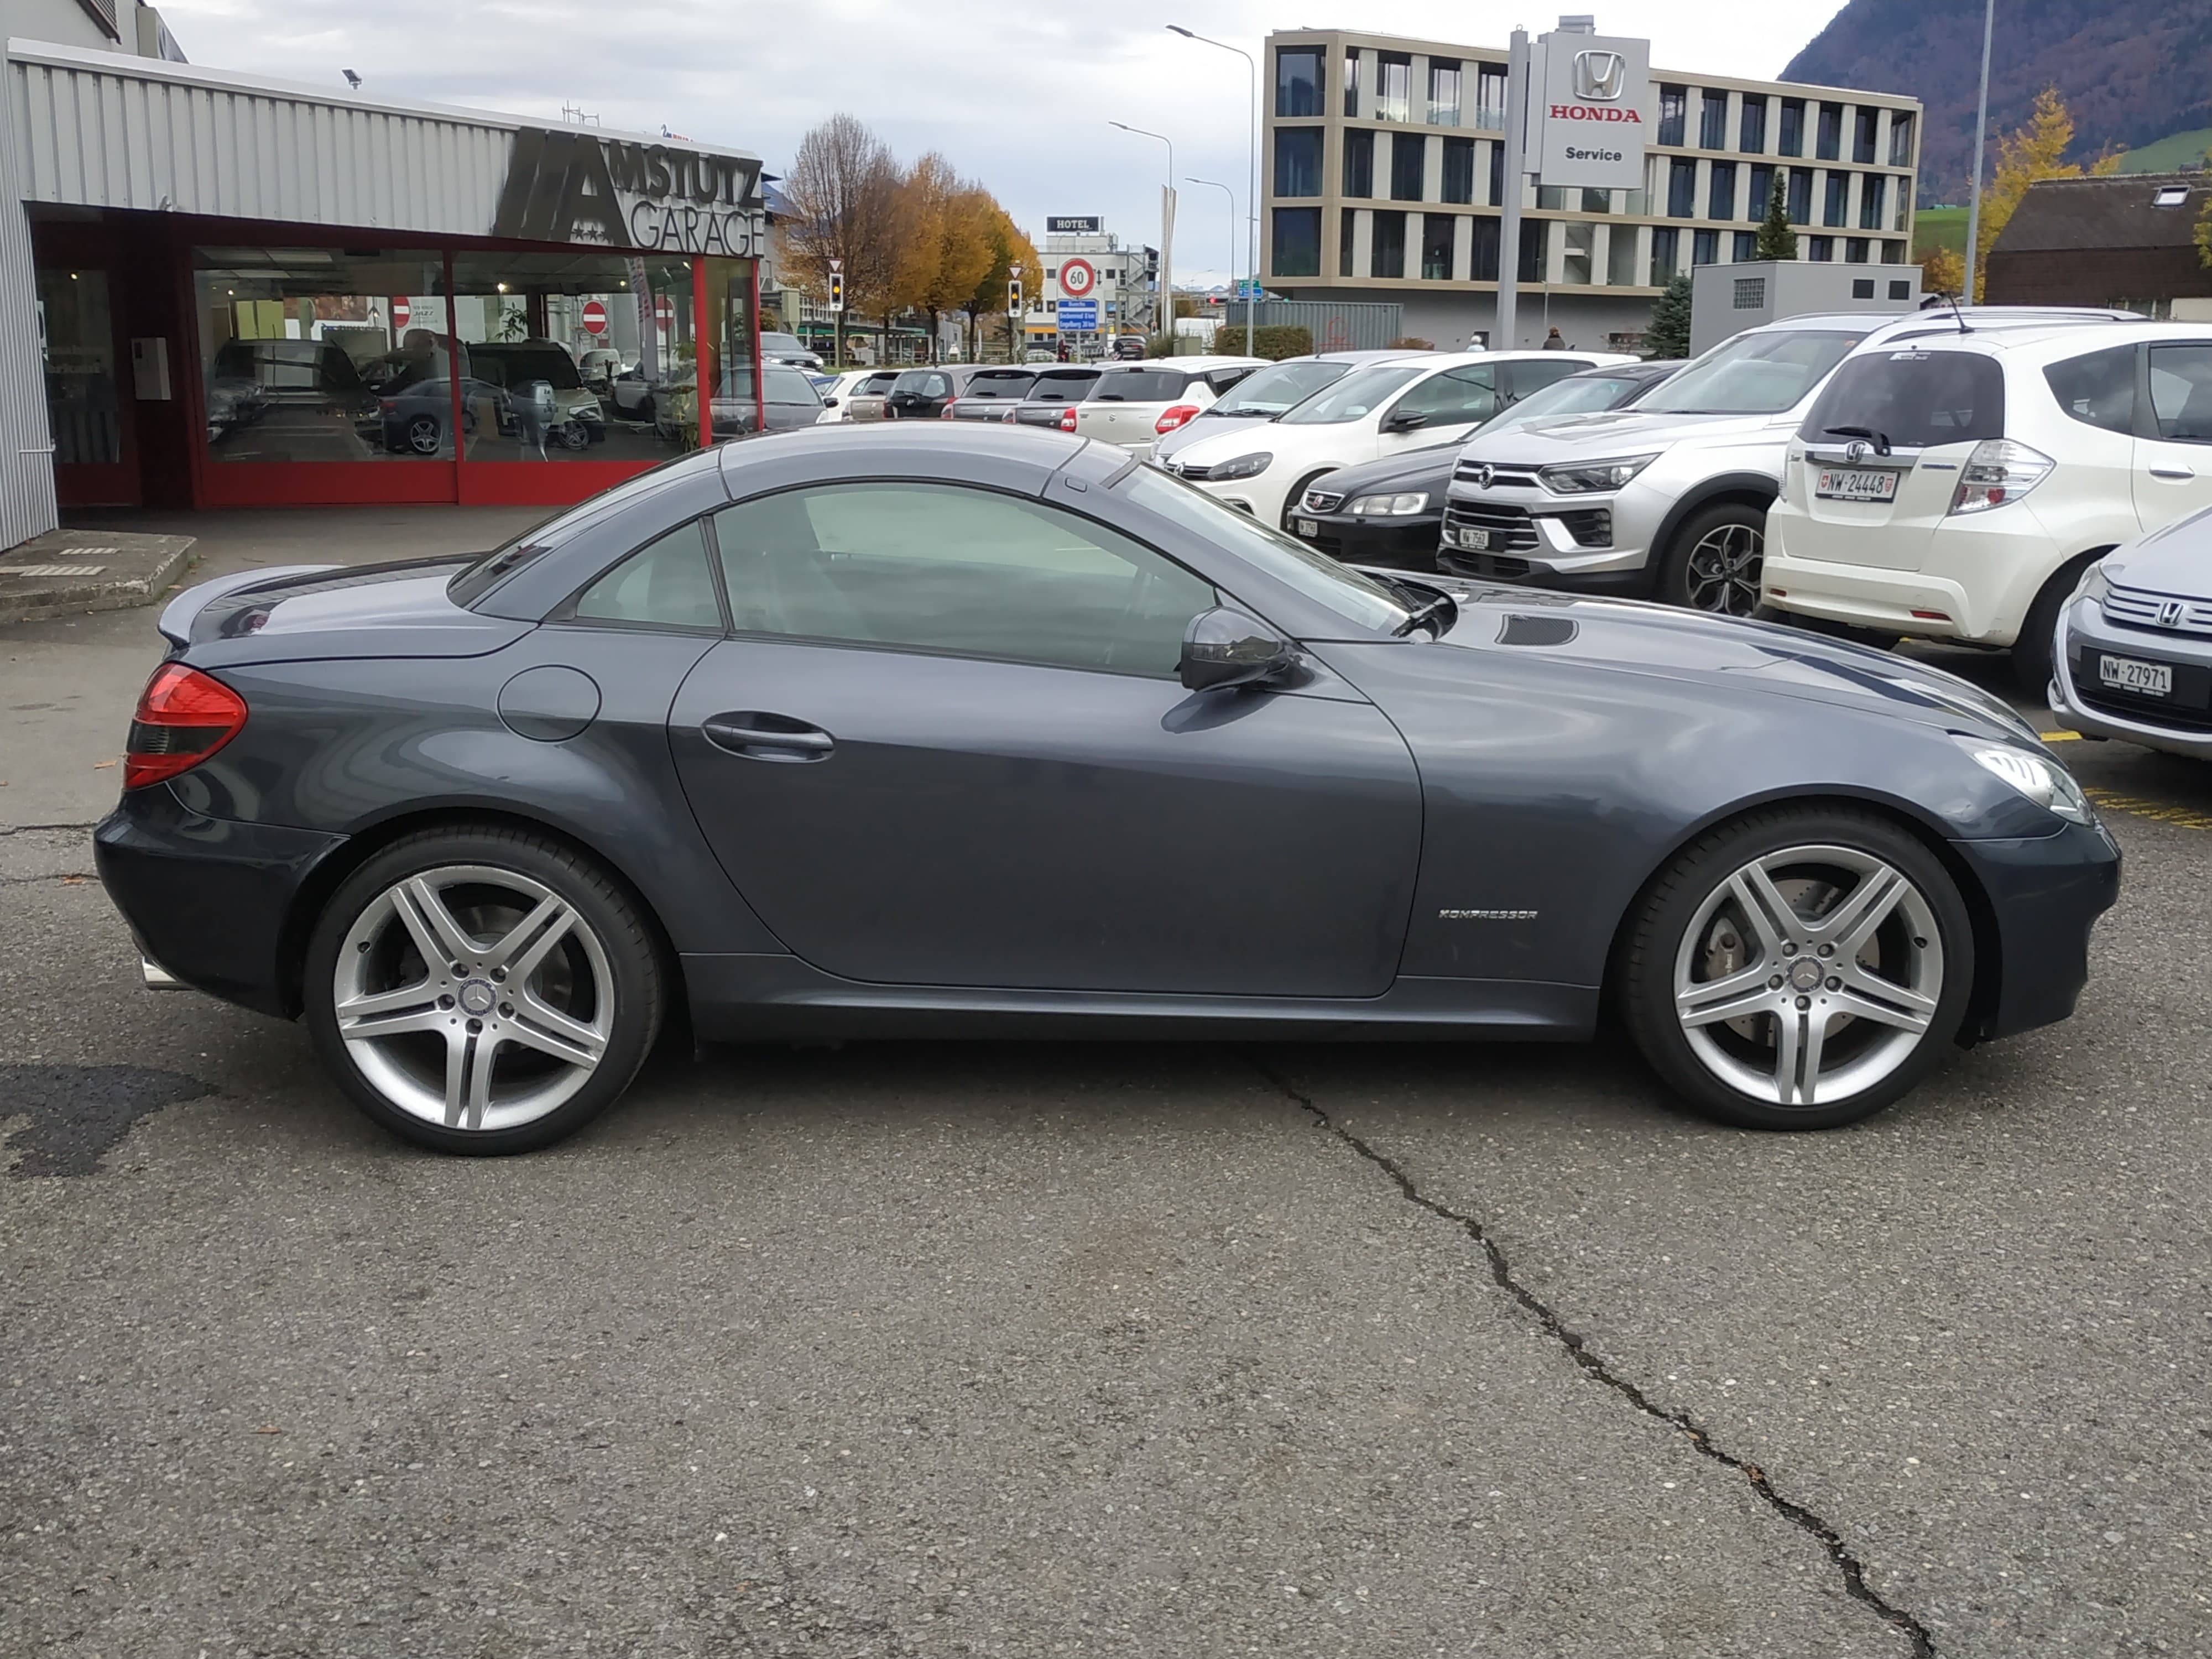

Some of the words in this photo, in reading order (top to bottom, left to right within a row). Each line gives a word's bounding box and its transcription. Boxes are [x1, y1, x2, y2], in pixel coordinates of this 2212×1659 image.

[1549, 105, 1642, 123] HONDA
[1565, 147, 1623, 161] Service
[631, 201, 764, 258] GARAGE
[1057, 220, 1089, 228] HOTEL
[1070, 271, 1084, 284] 60
[1439, 909, 1538, 919] KOMPRESSOR
